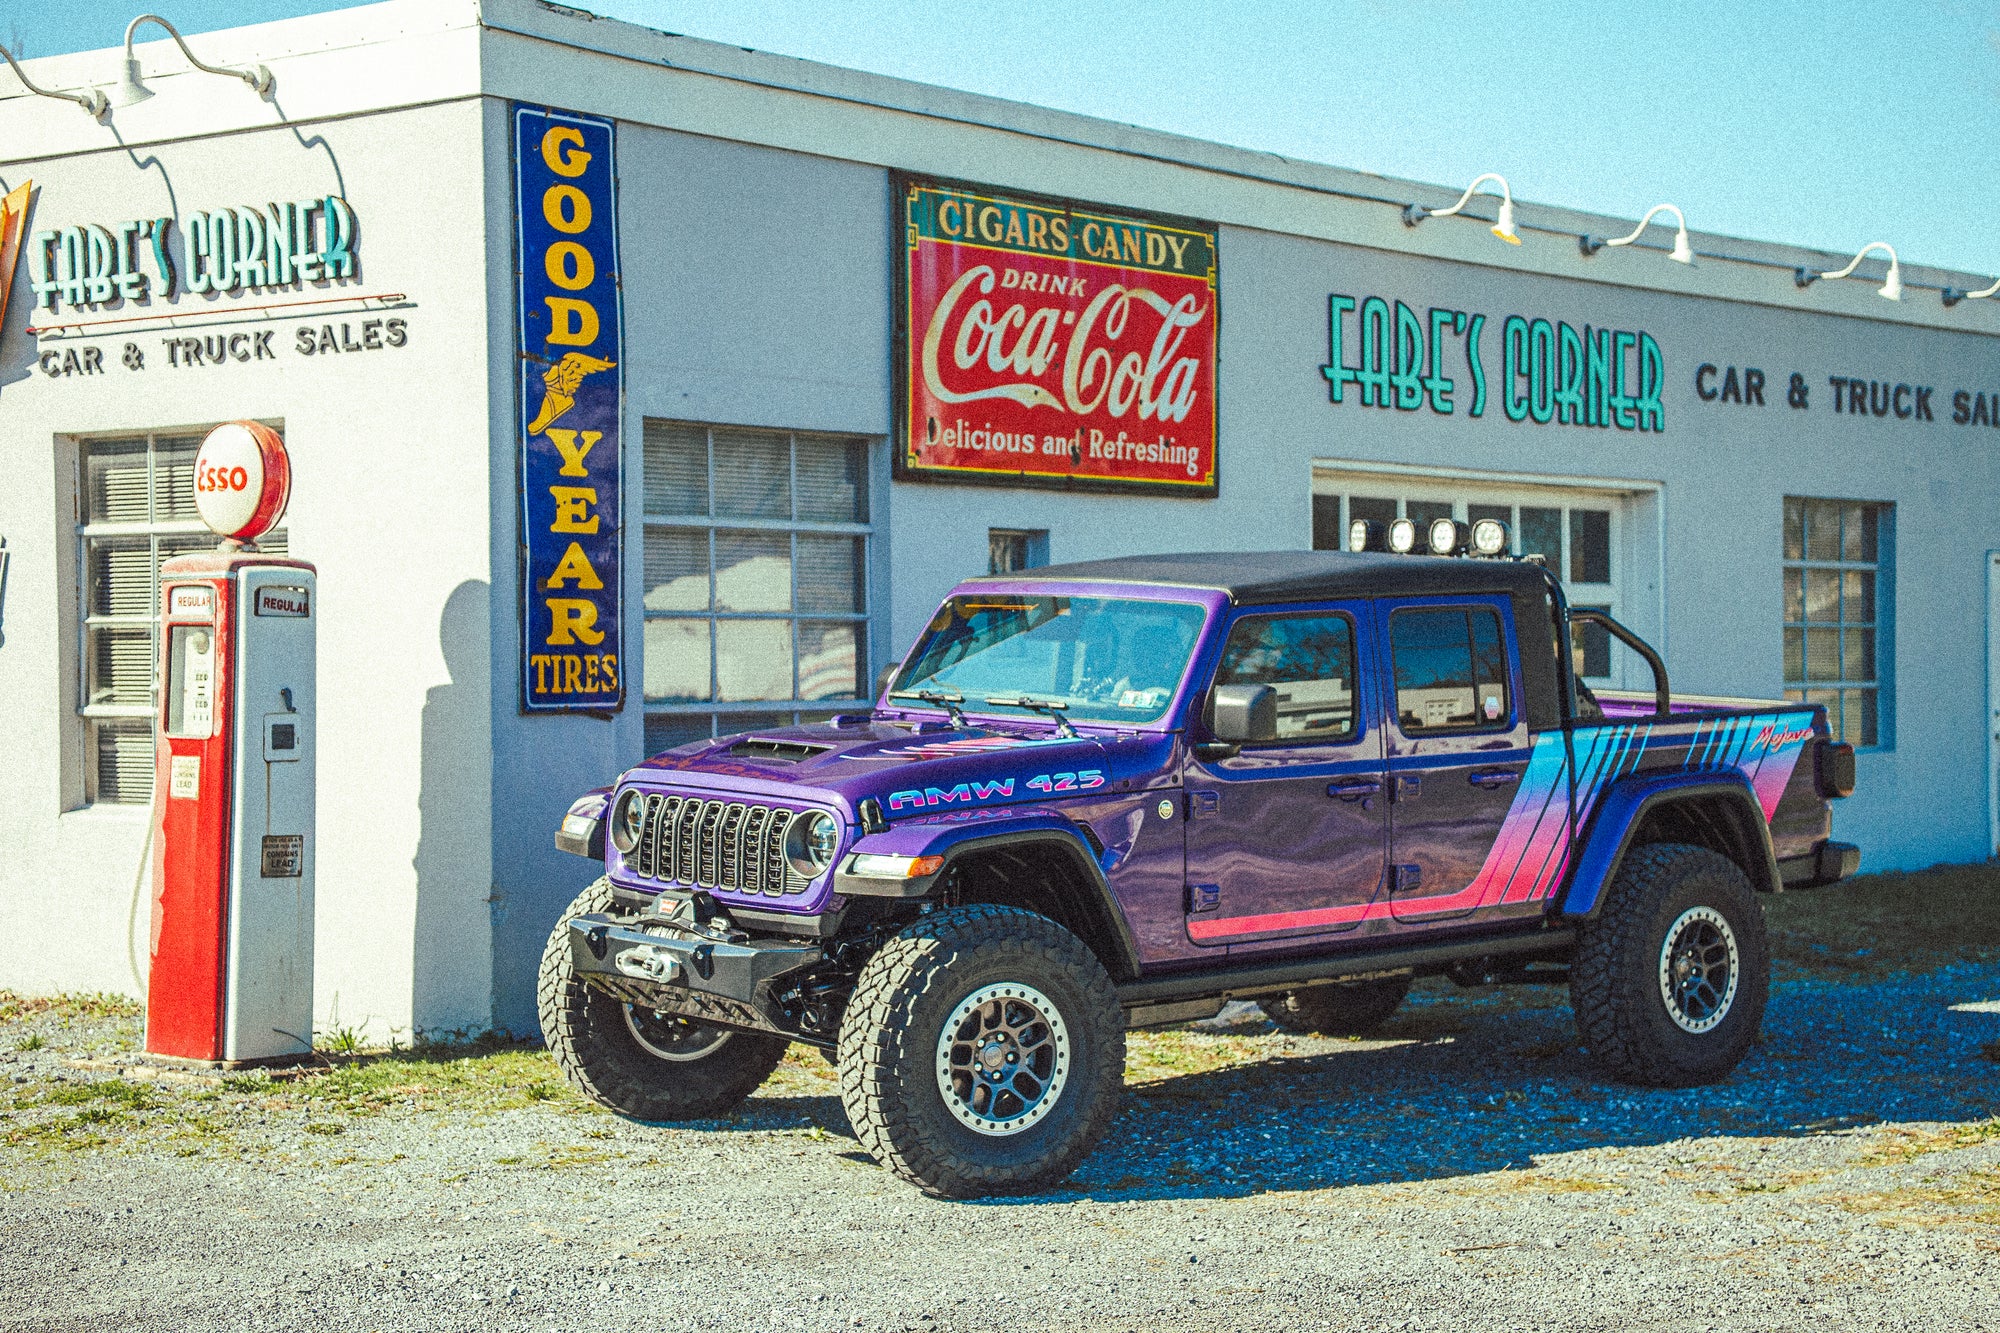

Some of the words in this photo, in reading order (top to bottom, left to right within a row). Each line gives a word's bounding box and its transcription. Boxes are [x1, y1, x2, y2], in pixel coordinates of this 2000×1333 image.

[31, 217, 176, 308] FABE'S
[184, 195, 355, 295] CORNER
[939, 199, 1070, 252] CIGARS
[1082, 222, 1191, 270] CANDY
[1000, 268, 1088, 298] DRINK
[39, 346, 104, 378] CAR
[121, 342, 145, 371] &
[163, 331, 276, 368] TRUCK
[296, 318, 409, 356] SALES
[1319, 293, 1488, 418] FABE'S
[1504, 314, 1665, 433] CORNER
[1695, 361, 1767, 407] CAR
[1787, 371, 1809, 410] &
[1829, 375, 1934, 422] TRUCK
[926, 416, 1035, 454] Delicious
[1042, 428, 1081, 458] and
[1088, 428, 1200, 477] Refreshing
[177, 595, 211, 607] REGULAR
[263, 597, 308, 614] REGULAR
[531, 654, 618, 695] TIRES
[1750, 723, 1815, 753] Mojave
[888, 778, 1015, 811] AMW
[1026, 769, 1105, 793] 425
